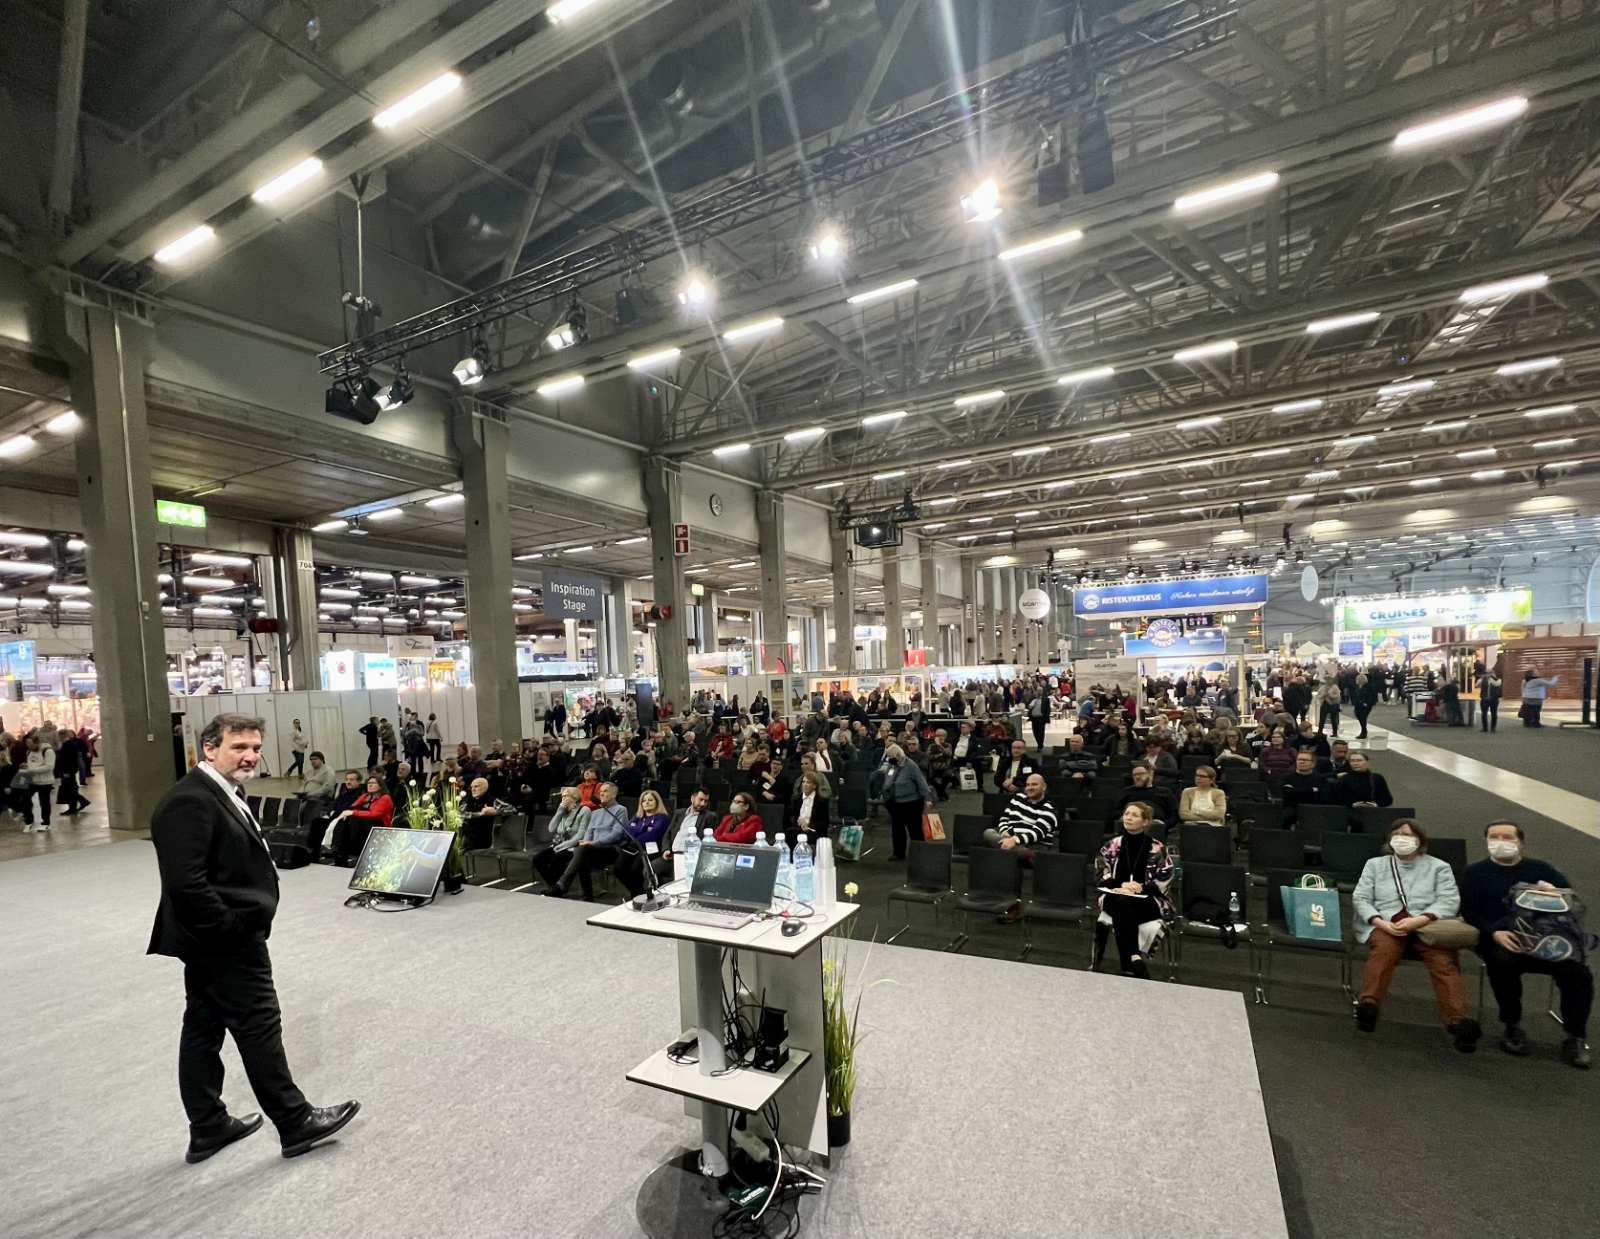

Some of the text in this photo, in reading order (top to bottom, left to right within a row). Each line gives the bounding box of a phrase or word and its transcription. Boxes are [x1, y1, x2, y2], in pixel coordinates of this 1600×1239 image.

[550, 581, 596, 597] Inspiration
[563, 599, 587, 612] Stage
[1370, 608, 1428, 620] CRUISES
